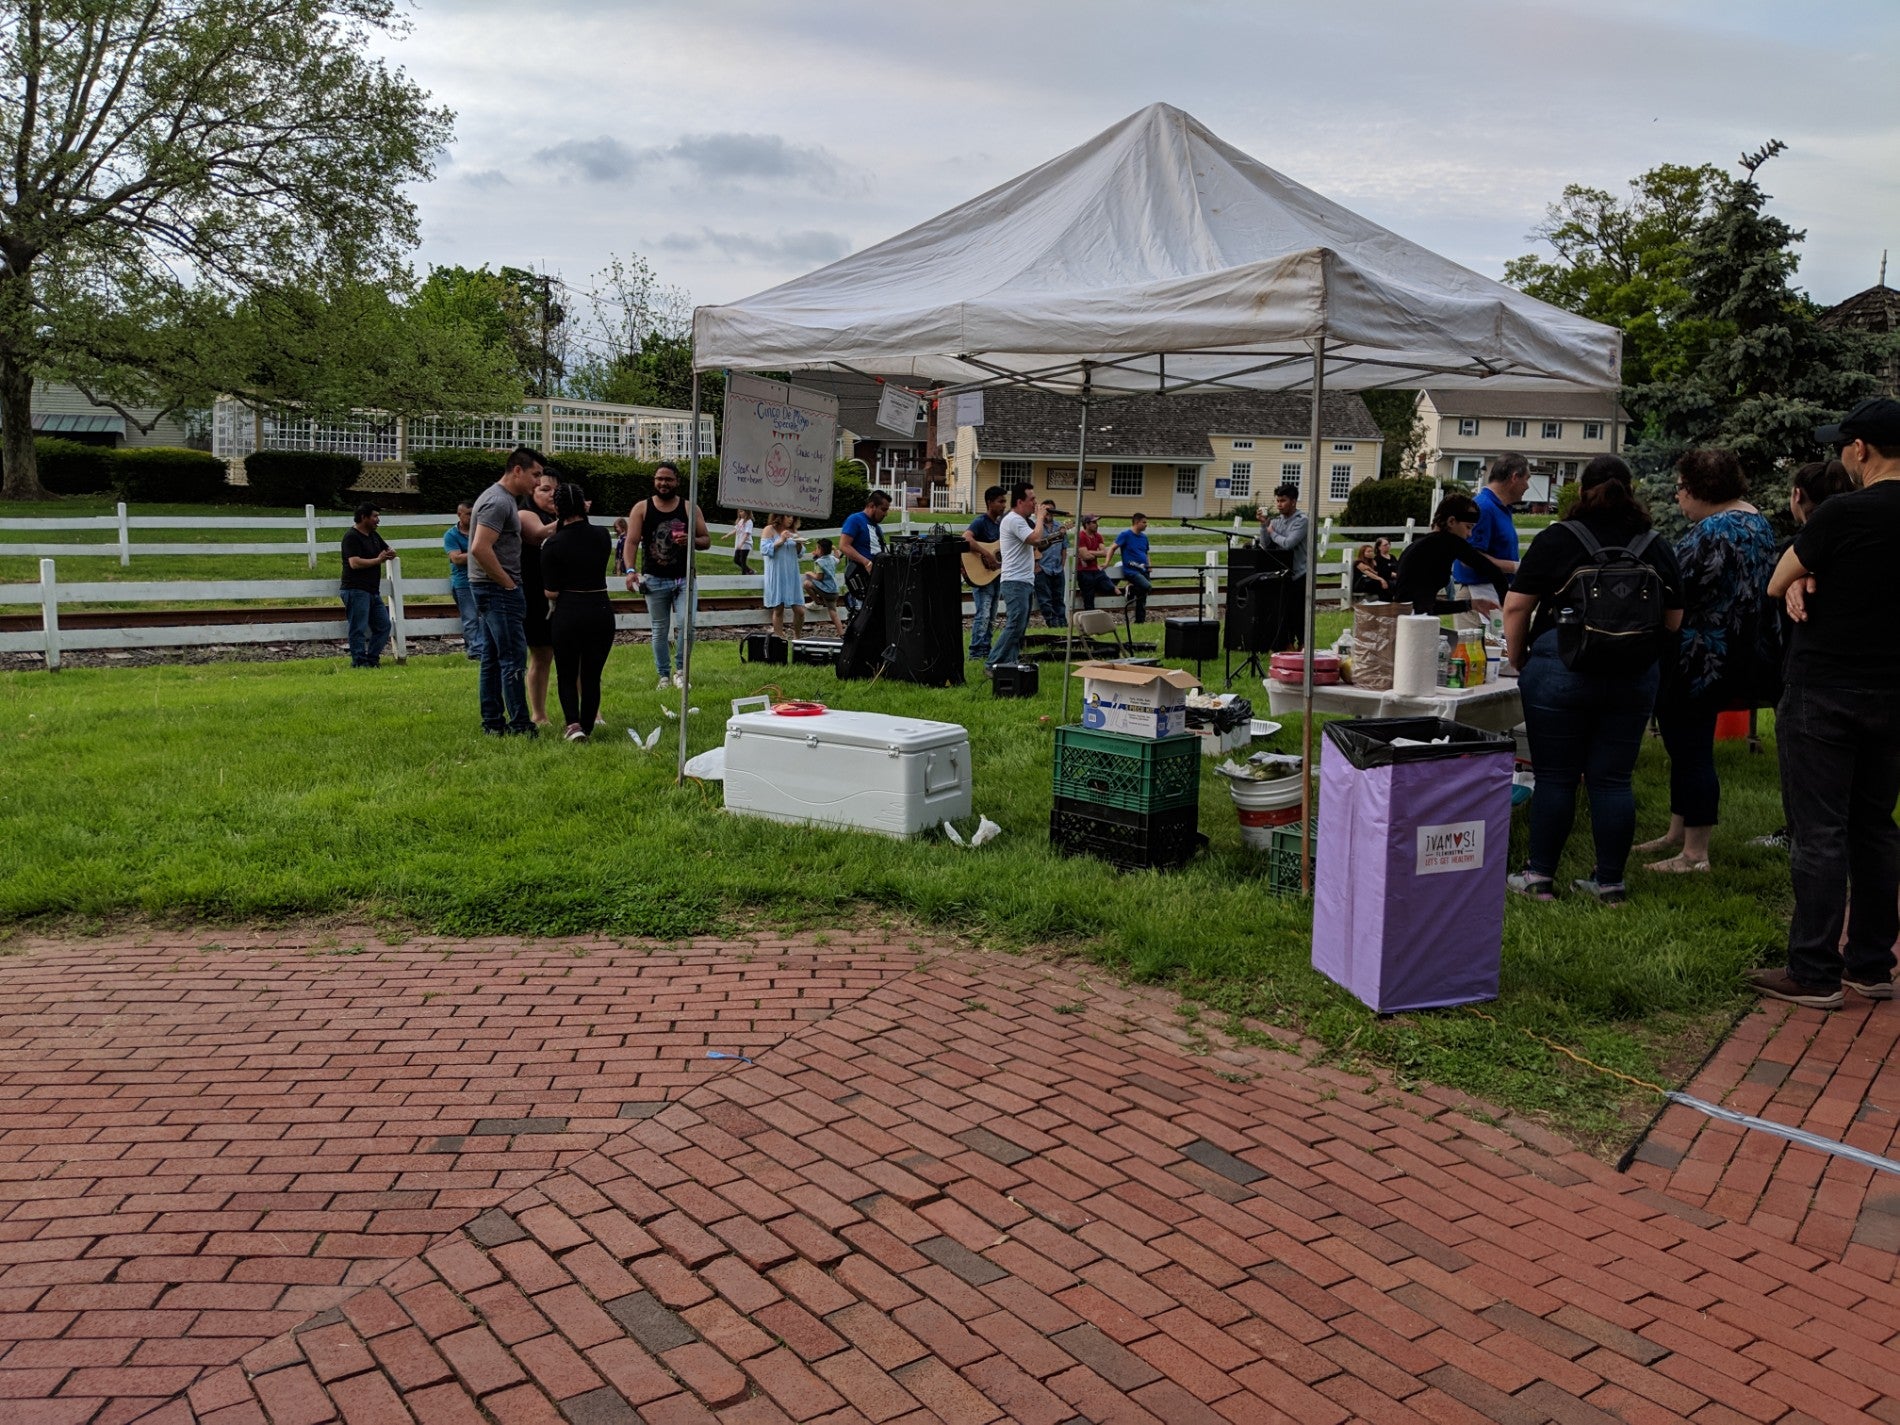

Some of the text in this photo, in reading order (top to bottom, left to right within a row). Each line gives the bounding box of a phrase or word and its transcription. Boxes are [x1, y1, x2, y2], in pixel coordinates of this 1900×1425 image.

[757, 402, 810, 431] Cinco De Mayo
